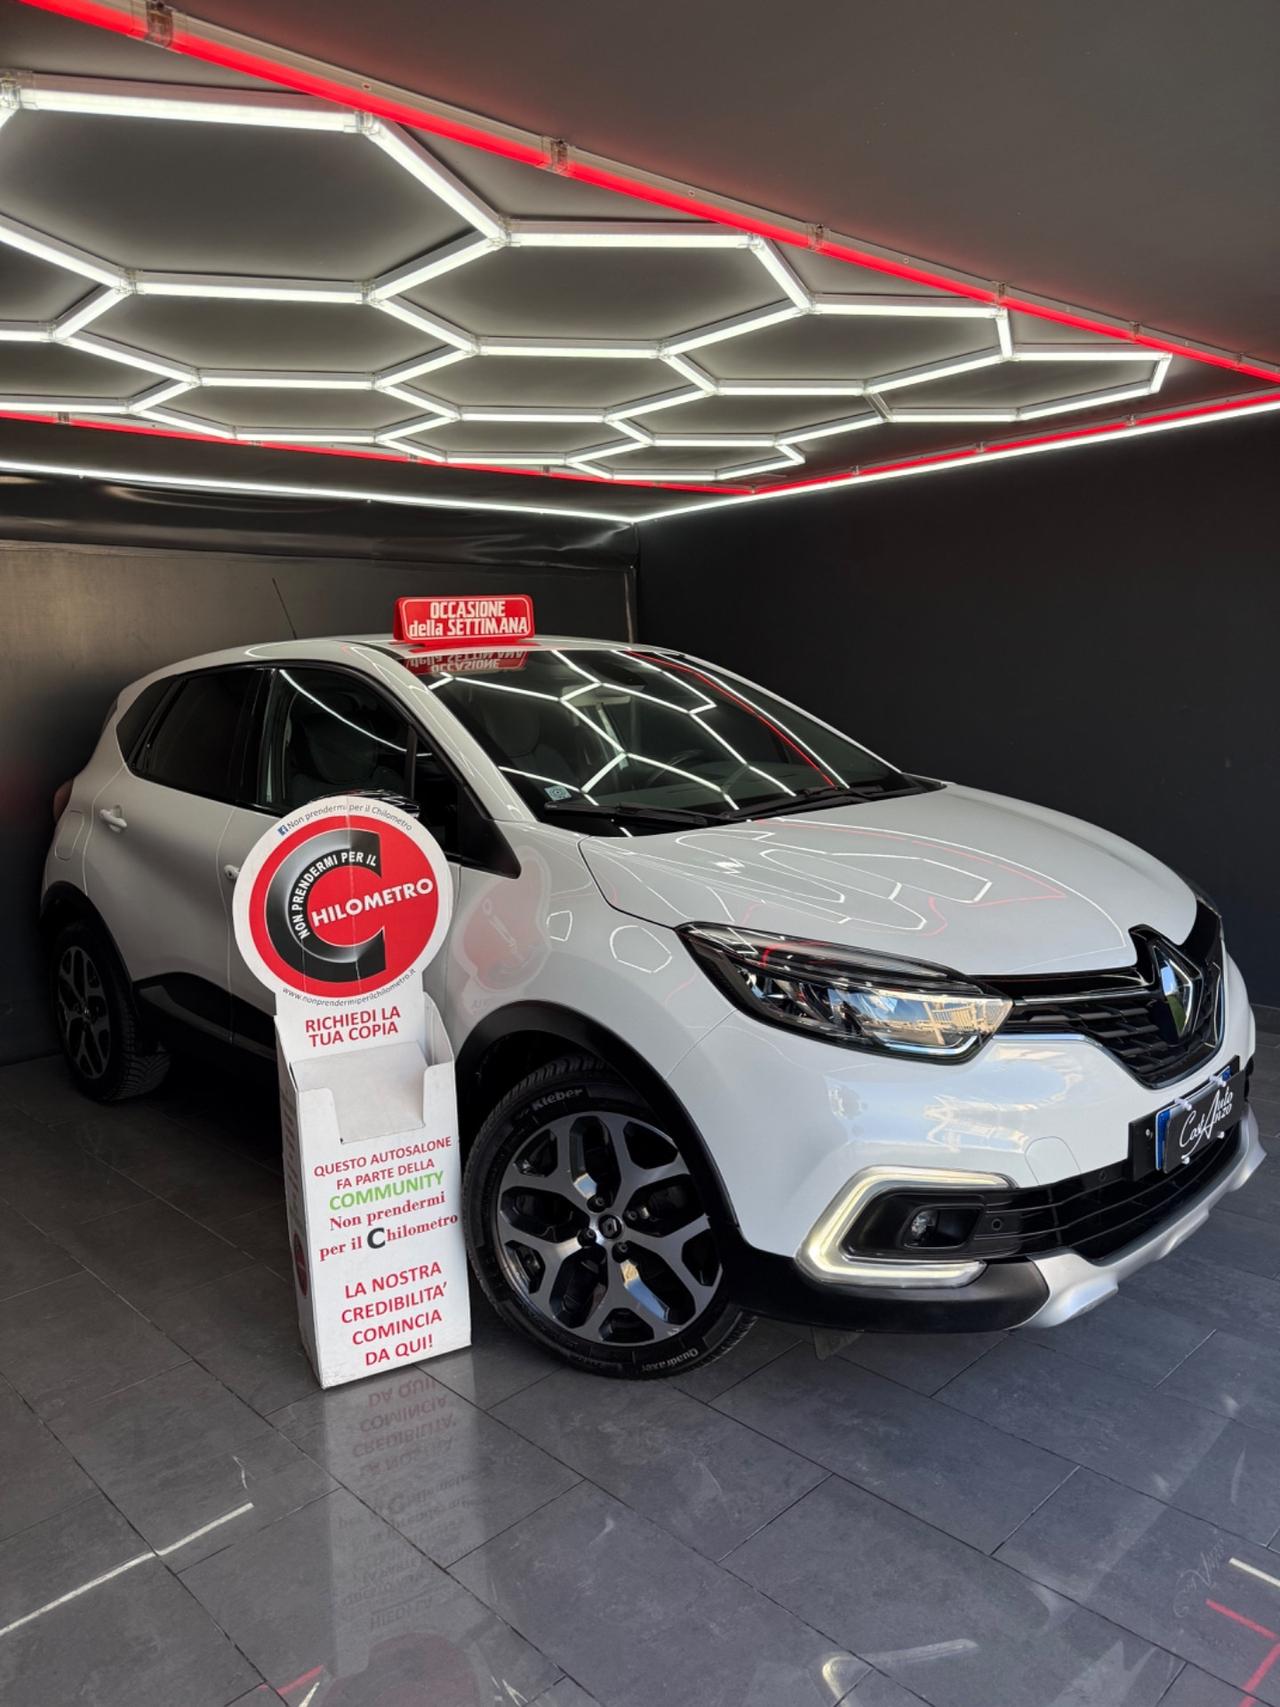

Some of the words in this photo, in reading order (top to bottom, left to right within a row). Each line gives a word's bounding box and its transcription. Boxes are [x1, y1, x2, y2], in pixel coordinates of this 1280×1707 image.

[430, 601, 506, 619] OCCASIONE
[409, 619, 443, 637] della
[447, 616, 528, 636] SETTIMANA
[287, 816, 304, 830] Non
[348, 804, 364, 813] per
[364, 804, 370, 812] il
[371, 806, 413, 831] Chilometro
[341, 851, 364, 863] PER
[366, 854, 377, 867] IL
[291, 854, 338, 911] PRENDERMI
[292, 914, 311, 940] NON
[305, 1009, 377, 1033] RICHIEDI
[381, 1006, 401, 1020] LA
[309, 1030, 344, 1047] TUA
[348, 1021, 399, 1041] COPIA
[532, 1088, 583, 1111] Kleber
[314, 1157, 367, 1177] QUESTO
[370, 1136, 452, 1166] AUTOSALONE
[336, 1176, 352, 1190] FA
[355, 1169, 394, 1186] PARTE
[399, 1158, 435, 1177] DELLA
[329, 1171, 445, 1211] COMMUNITY
[330, 1215, 362, 1231] Non
[367, 1191, 446, 1226] prendermi
[319, 1245, 347, 1261] per
[351, 1236, 363, 1251] il
[367, 1214, 458, 1249] Chilometro
[345, 1282, 367, 1299] LA
[372, 1261, 442, 1293] NOSTRA
[352, 1309, 442, 1346] COMINCIA
[365, 1348, 390, 1366] DA
[395, 1334, 433, 1358] QUI!
